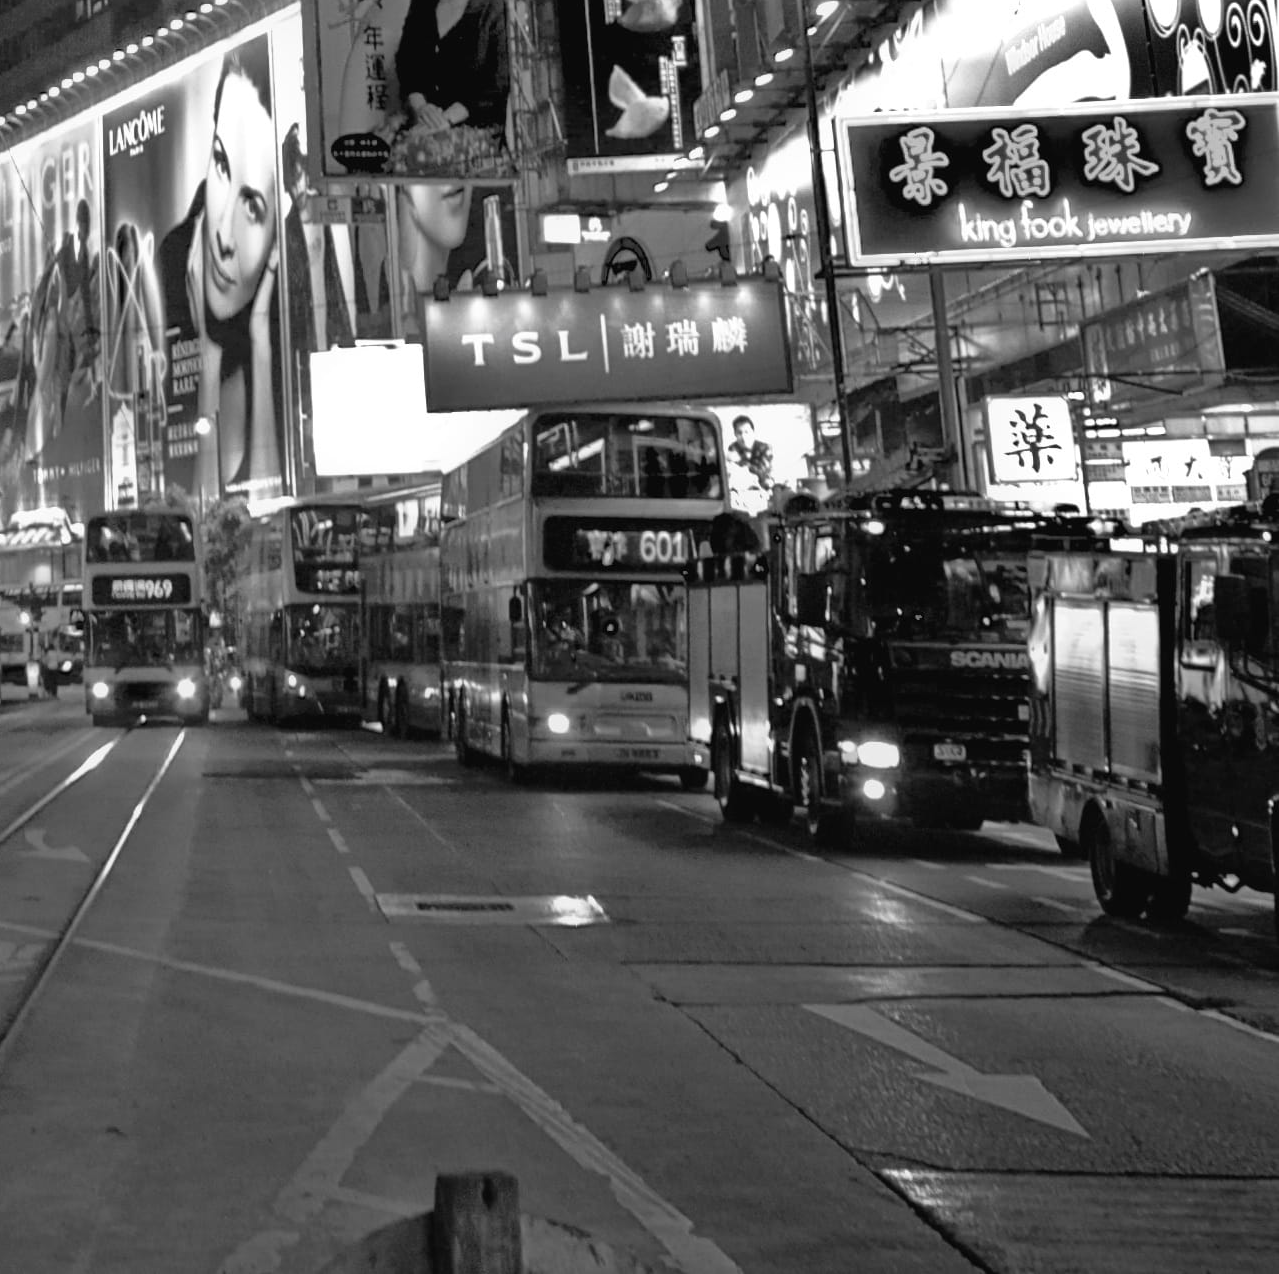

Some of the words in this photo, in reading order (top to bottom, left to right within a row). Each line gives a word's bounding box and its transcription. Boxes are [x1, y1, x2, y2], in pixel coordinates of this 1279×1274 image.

[109, 105, 166, 157] LANCÔME
[889, 108, 1247, 206] 景福珠寶
[958, 201, 1018, 248] king
[1019, 197, 1085, 240] fook
[1087, 210, 1193, 242] jewellery
[461, 320, 589, 367] TSL
[621, 315, 748, 360] 謝瑞麟
[639, 529, 688, 565] 601
[144, 578, 173, 599] 969
[950, 650, 1031, 669] SCANIA
